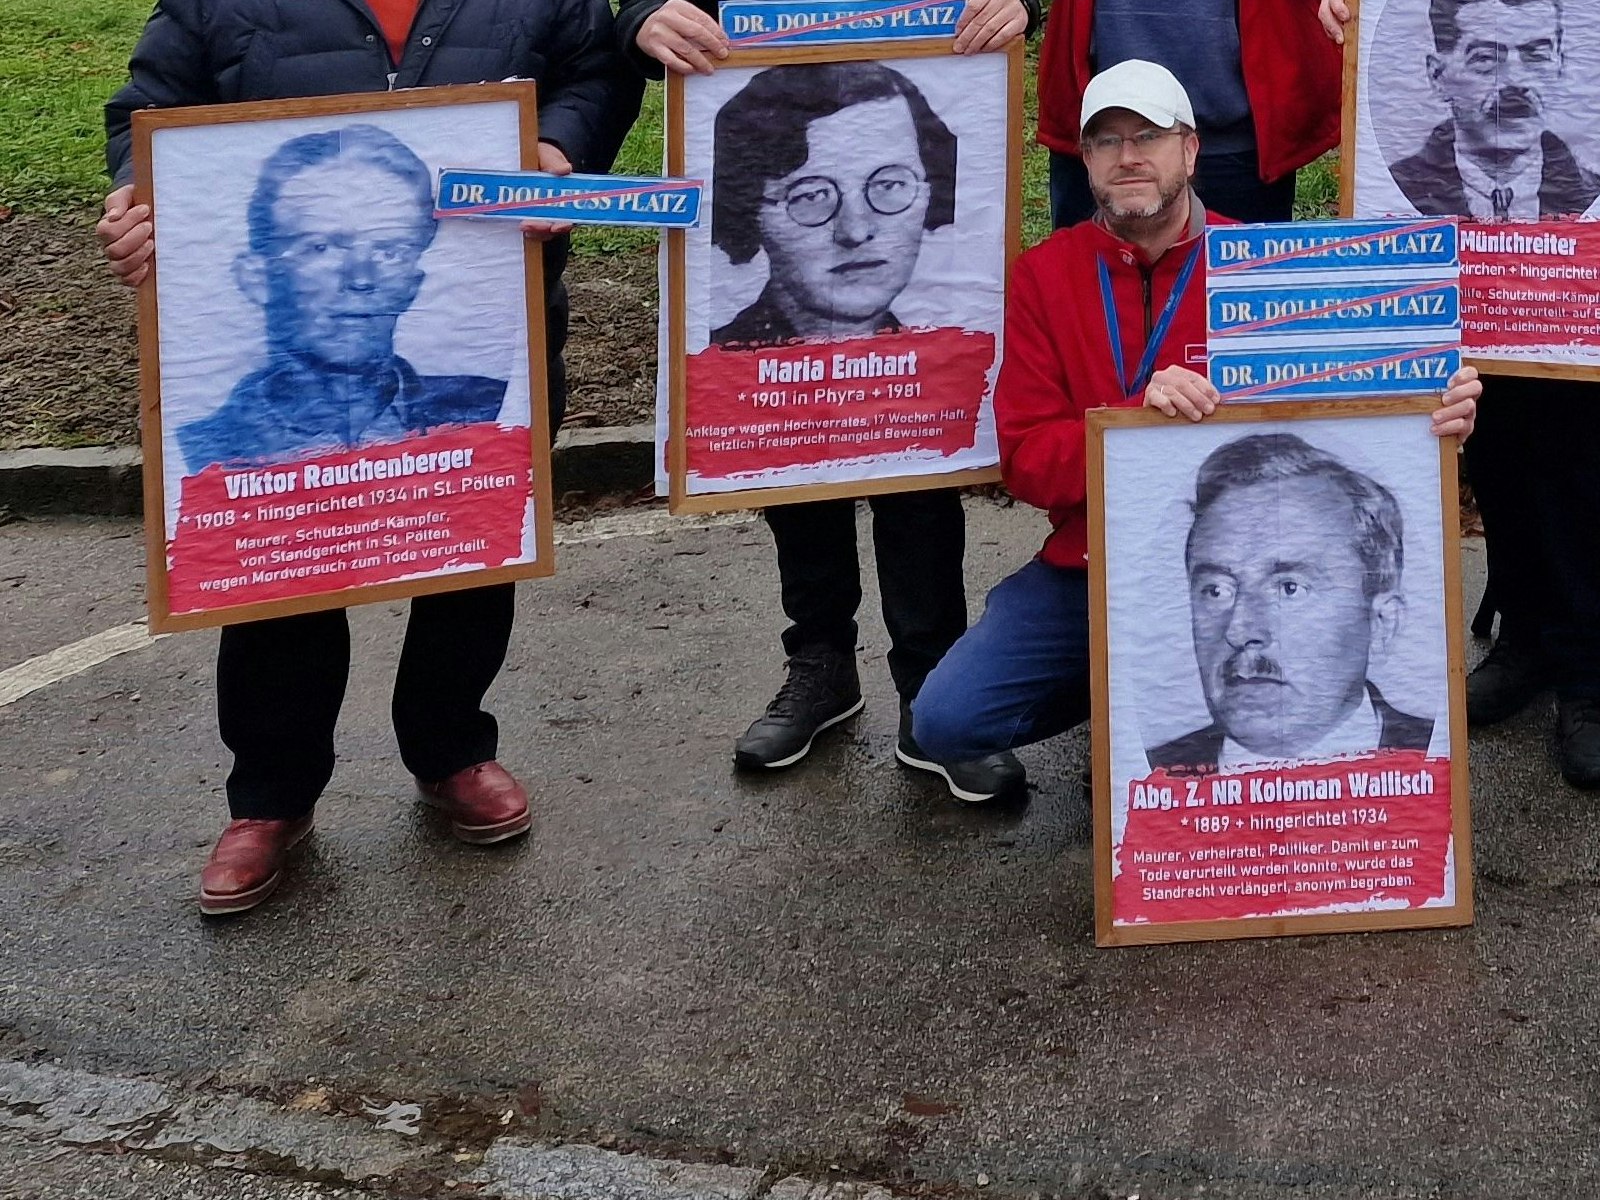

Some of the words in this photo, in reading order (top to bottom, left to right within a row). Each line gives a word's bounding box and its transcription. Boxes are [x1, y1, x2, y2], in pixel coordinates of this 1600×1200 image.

[733, 15, 770, 33] DR.
[777, 10, 884, 30] DOLLFUSS
[892, 6, 955, 27] PLATZ
[451, 184, 491, 204] DR.
[498, 186, 611, 210] DOLLFUSS
[618, 193, 687, 213] PLATZ
[1221, 240, 1256, 260] DR.
[1264, 236, 1371, 258] DOLLFUSS
[1379, 233, 1444, 254] PLATZ
[1461, 230, 1577, 255] Münichreiter
[1459, 263, 1505, 275] kirchen
[1521, 263, 1598, 281] hingerichtet
[1221, 302, 1258, 322] DR.
[1265, 299, 1373, 320] DOLLFUSS
[1380, 295, 1445, 316] PLATZ
[1461, 305, 1477, 314] um
[1481, 303, 1508, 315] Tode
[1572, 309, 1591, 319] auf
[1461, 321, 1500, 332] tragen,
[1504, 321, 1560, 333] Leichnam
[758, 358, 824, 384] Maria
[832, 351, 917, 380] Emhart
[1222, 365, 1258, 387] DR.
[1266, 362, 1374, 384] DOLLFUSS
[1382, 358, 1448, 380] PLATZ
[751, 391, 785, 407] 1901
[793, 390, 807, 404] in
[815, 387, 865, 409] Phyra
[887, 383, 921, 398] 1981
[685, 425, 735, 438] Anklage
[739, 422, 780, 436] wegen
[784, 415, 870, 432] Hochverrates,
[874, 414, 885, 425] 17
[888, 411, 936, 424] Wochen
[940, 408, 967, 422] Haft,
[709, 438, 755, 452] letzlich
[758, 434, 825, 449] Freispruch
[829, 430, 881, 444] mangels
[885, 426, 943, 439] Beweisen
[225, 469, 297, 500] Viktor
[303, 448, 474, 489] Rauchenberger
[195, 512, 235, 529] 1908
[257, 494, 364, 523] hingerichtet
[369, 487, 407, 505] 1934
[413, 485, 427, 499] in
[434, 482, 456, 498] St.
[461, 474, 515, 493] Pölten
[235, 533, 292, 551] Maurer,
[296, 510, 450, 543] Schutzbund-Kämpfer,
[240, 554, 266, 568] von
[271, 541, 362, 567] Standgericht
[366, 538, 379, 550] in
[383, 536, 401, 548] St.
[405, 528, 450, 543] Pölten
[199, 575, 248, 592] wegen
[252, 560, 346, 585] Mordversuch
[350, 556, 380, 570] zum
[385, 550, 417, 565] Tode
[422, 539, 489, 560] verurteilt.
[1132, 784, 1180, 811] Abg.
[1186, 782, 1206, 807] Z.
[1212, 782, 1242, 804] NR
[1249, 777, 1342, 802] Koloman
[1349, 770, 1433, 798] Wallisch
[1194, 817, 1229, 833] 1889
[1250, 812, 1346, 833] hingerichtet
[1352, 809, 1388, 824] 1934
[1133, 849, 1185, 863] Maurer,
[1189, 846, 1264, 861] verheiratet,
[1269, 842, 1327, 857] Politiker.
[1331, 839, 1369, 853] Damit
[1374, 841, 1387, 852] er
[1392, 838, 1419, 849] zum
[1139, 868, 1170, 881] Tode
[1174, 864, 1236, 881] verurteilt
[1240, 862, 1289, 877] werden
[1293, 859, 1341, 874] konnte,
[1345, 856, 1385, 870] wurde
[1390, 856, 1413, 868] das
[1142, 885, 1215, 901] Standrecht
[1219, 882, 1291, 897] verlängert,
[1295, 878, 1347, 892] anonym
[1350, 874, 1415, 889] begraben.
